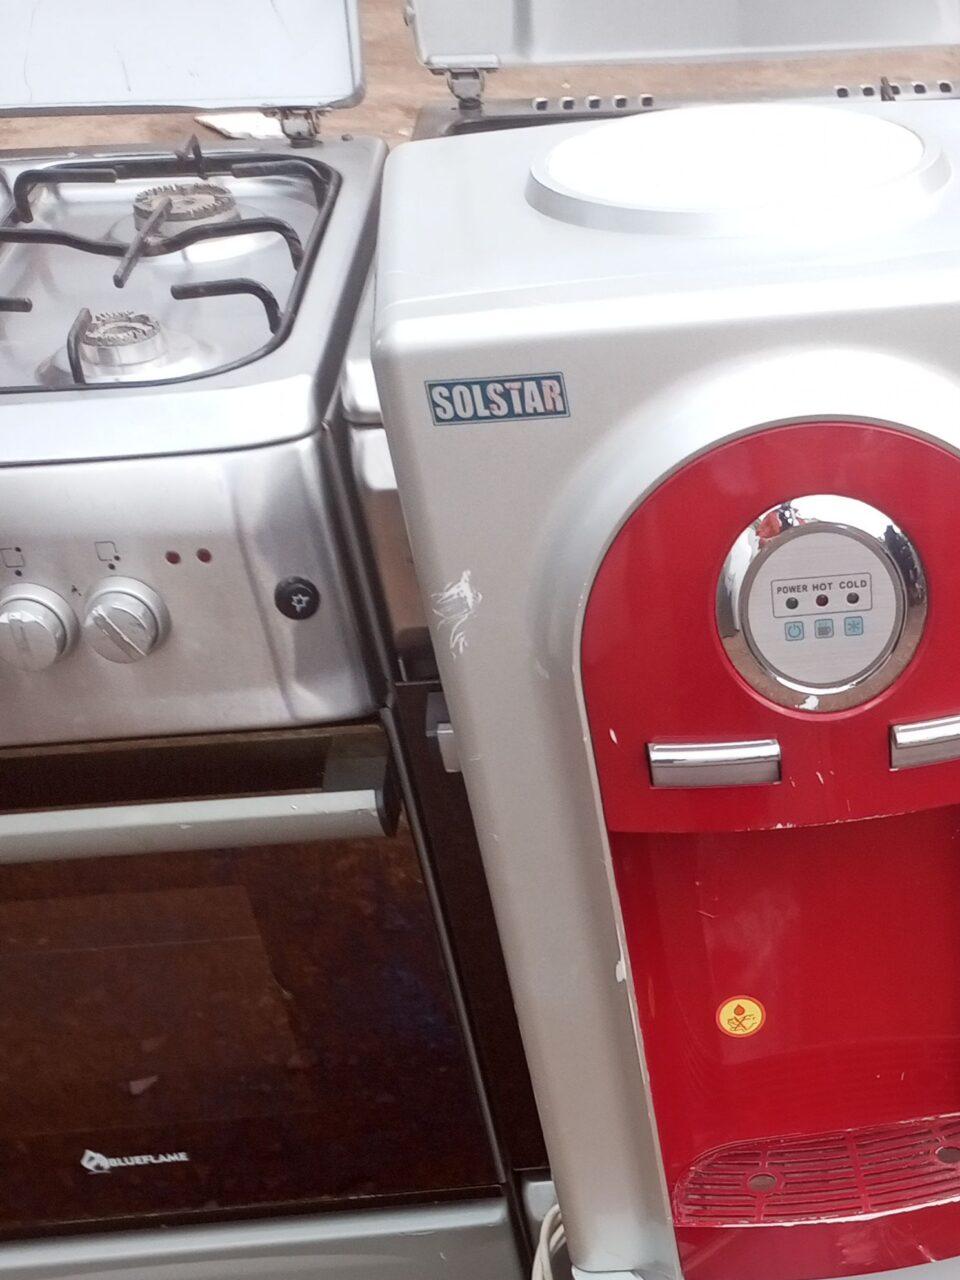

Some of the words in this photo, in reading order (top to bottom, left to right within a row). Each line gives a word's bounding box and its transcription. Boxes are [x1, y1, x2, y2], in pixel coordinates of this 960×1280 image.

[431, 379, 565, 420] SOLSTAR
[776, 584, 808, 595] POWER
[812, 582, 833, 592] HOT
[839, 580, 867, 590] COLD
[108, 1151, 189, 1168] BLUEFLAME
